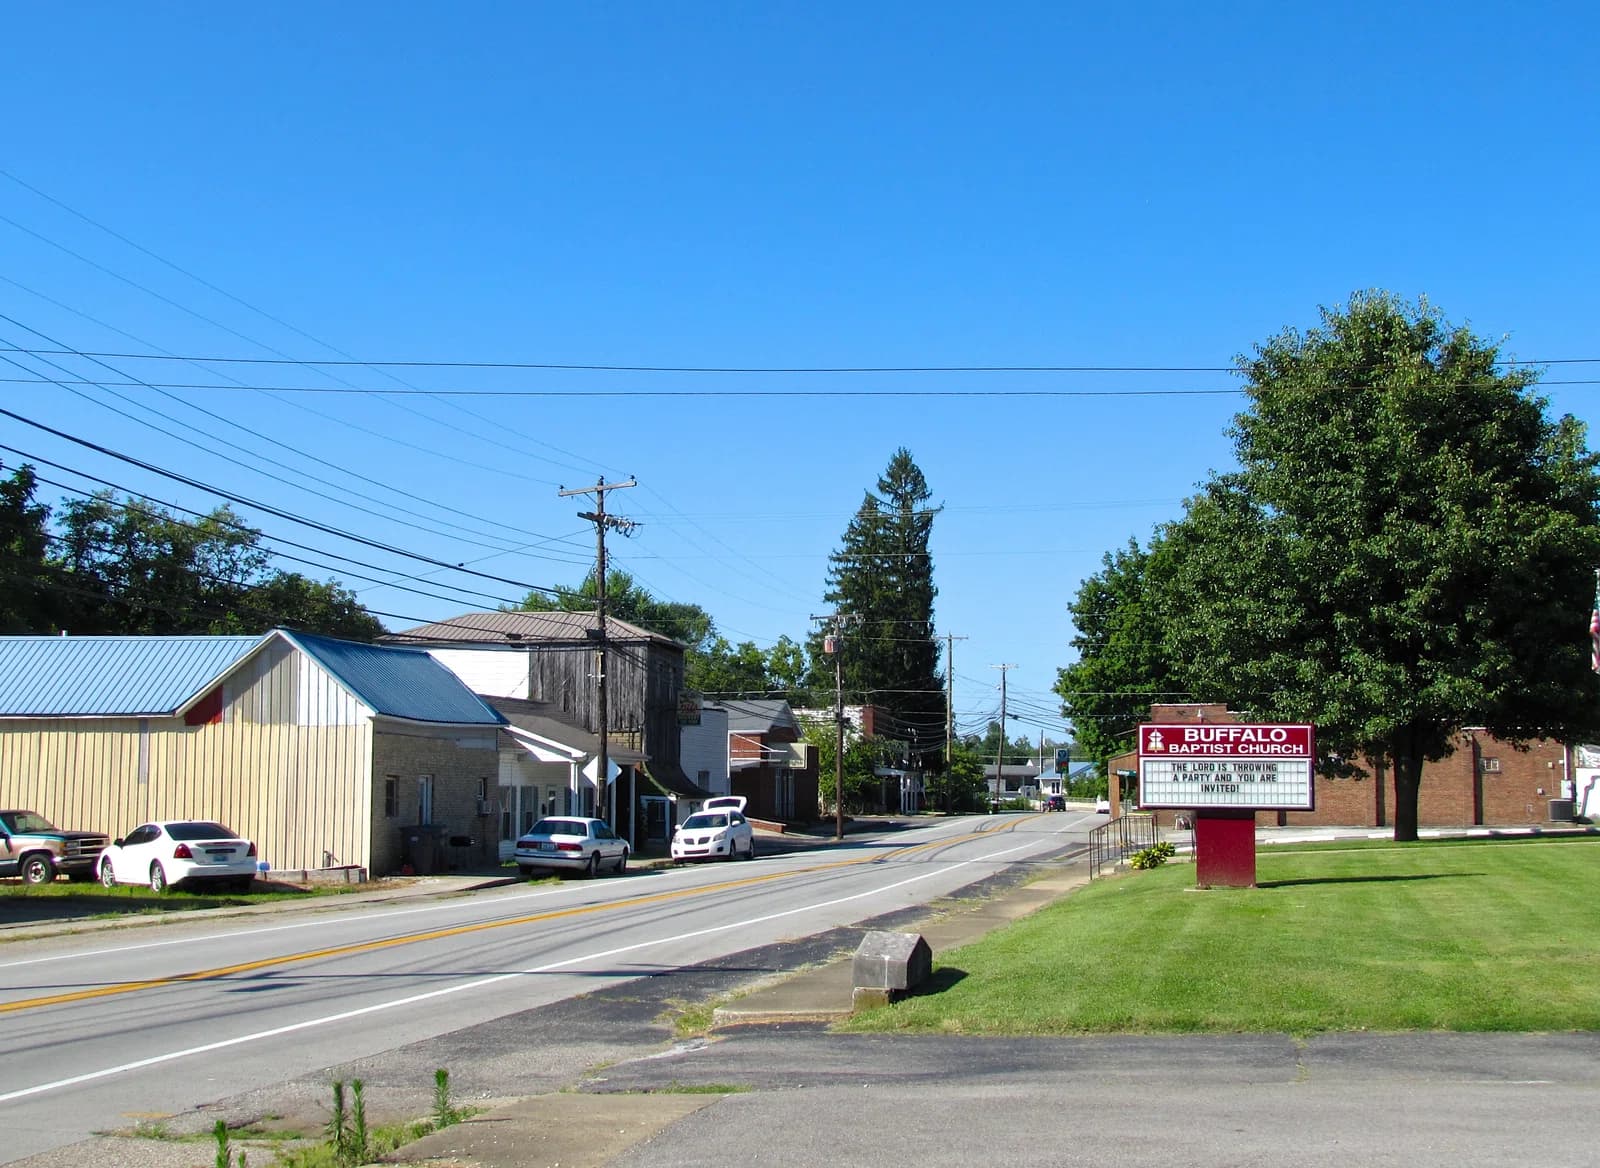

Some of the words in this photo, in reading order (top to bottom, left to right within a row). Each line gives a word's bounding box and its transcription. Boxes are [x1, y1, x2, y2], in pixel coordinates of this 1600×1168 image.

[1184, 728, 1287, 742] BUFFALO
[1168, 743, 1233, 754] BAPTIST
[1237, 743, 1304, 754] CHURCH
[1172, 763, 1187, 772] THE
[1192, 763, 1215, 772] LORD
[1218, 763, 1227, 772] IS
[1232, 763, 1277, 772] THROWING
[1173, 773, 1179, 782] A
[1182, 773, 1210, 782] PARTY
[1214, 773, 1232, 782] AND
[1238, 773, 1255, 782] YOU
[1260, 773, 1277, 782] ARE
[1201, 784, 1239, 793] INVITED!
